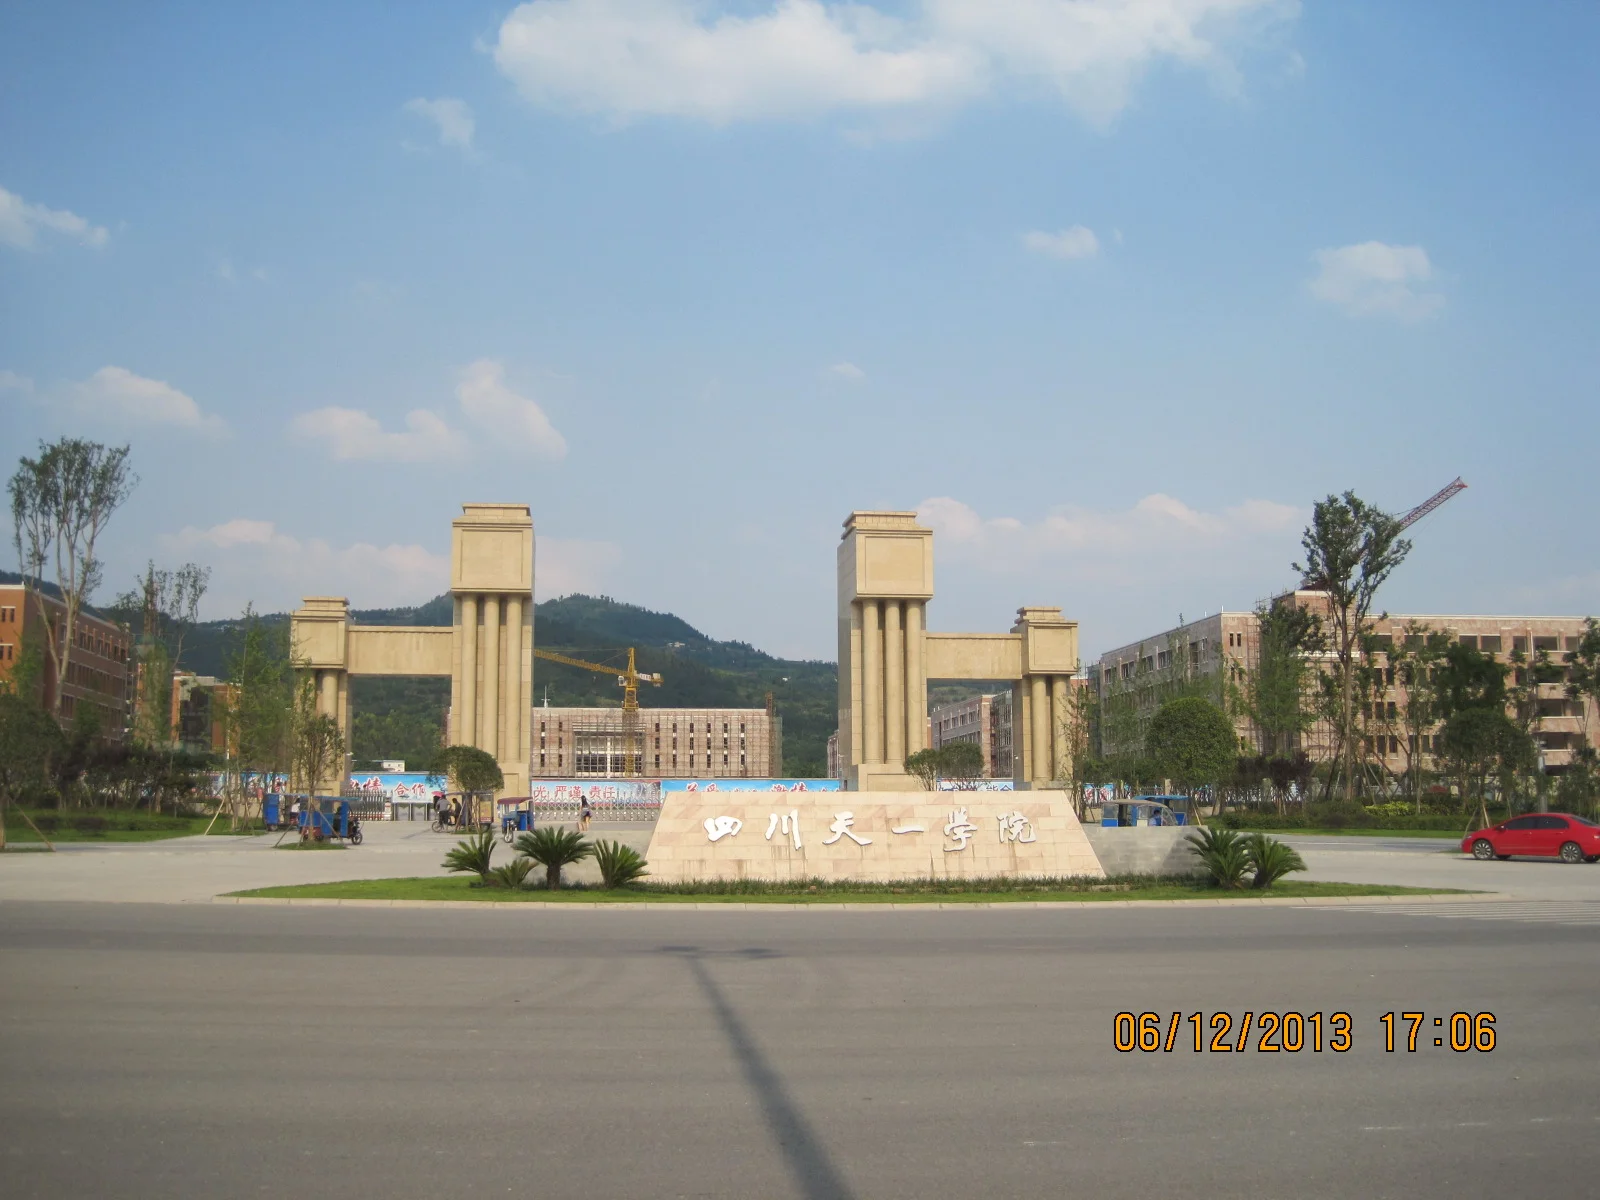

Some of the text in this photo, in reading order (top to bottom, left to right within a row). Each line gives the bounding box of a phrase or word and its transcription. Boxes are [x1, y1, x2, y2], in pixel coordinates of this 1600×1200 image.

[394, 782, 426, 796] 合作
[589, 786, 616, 800] 责任
[703, 807, 1036, 851] 四川天一学院
